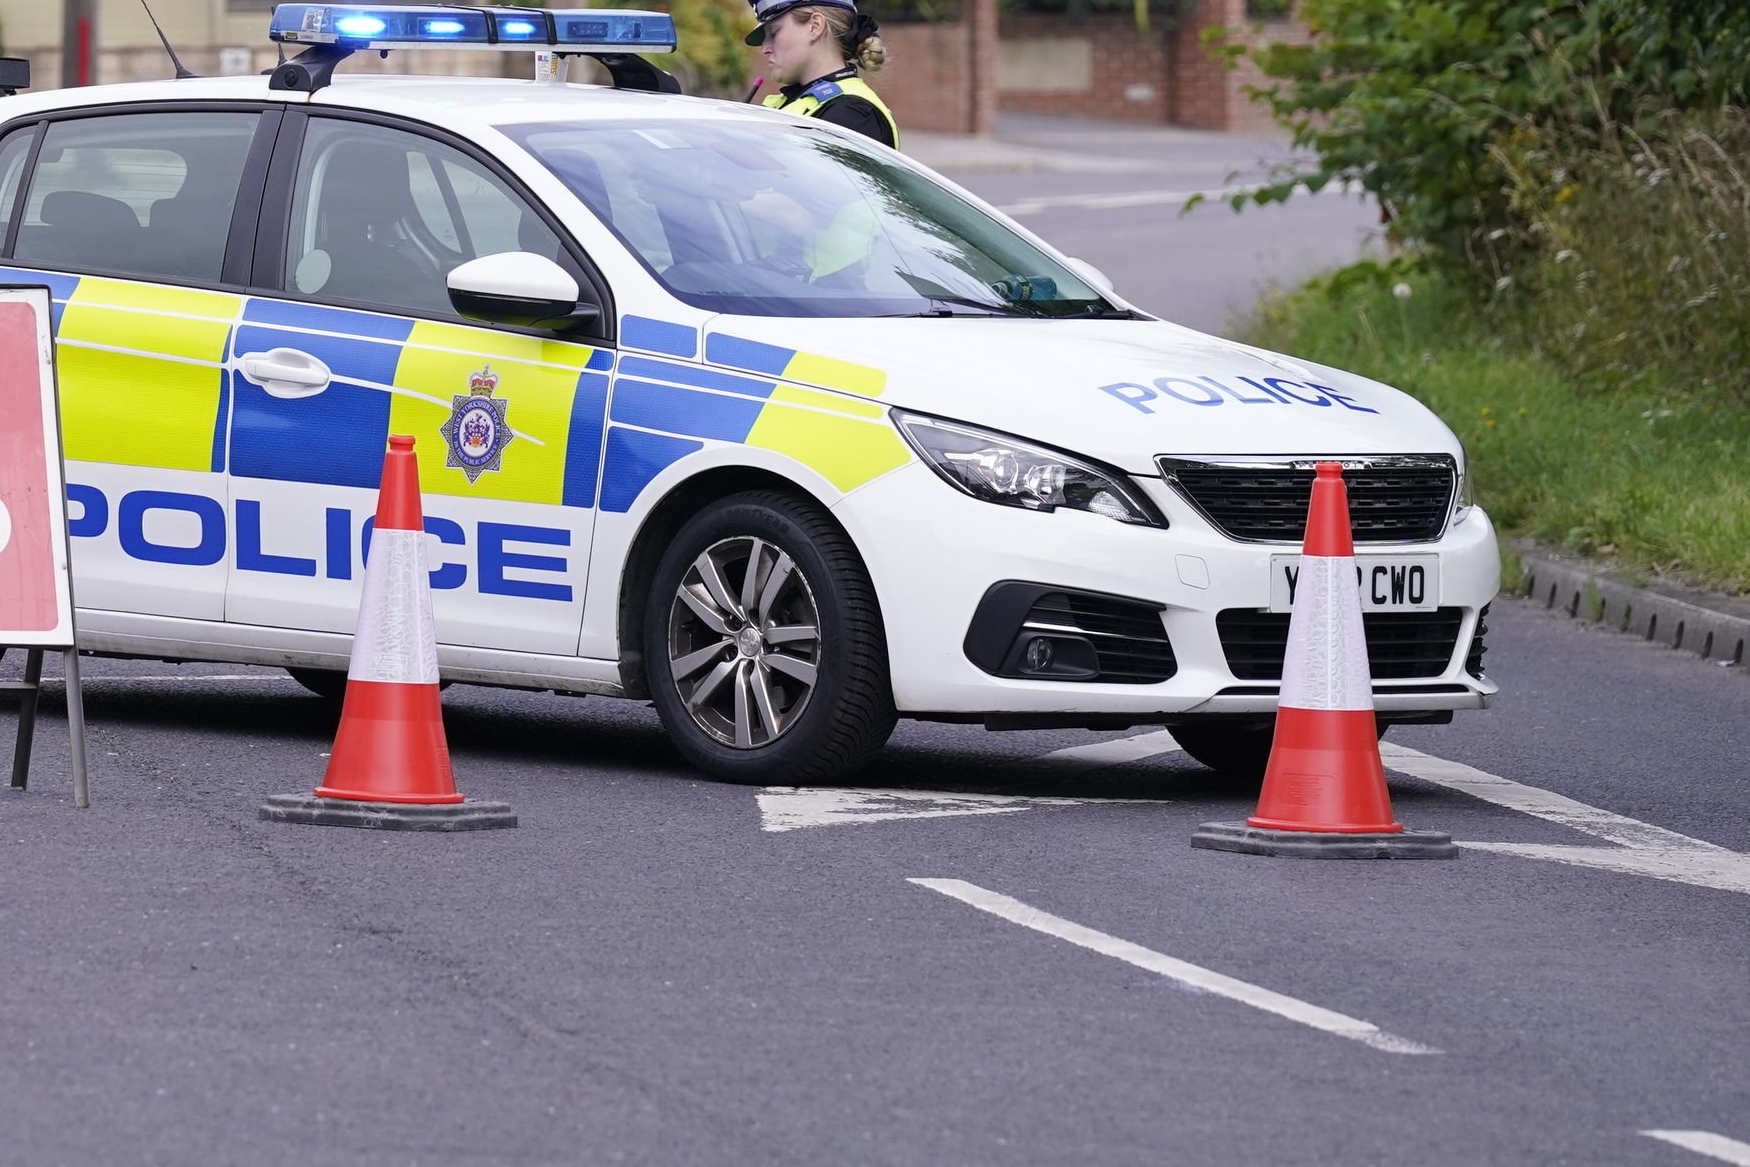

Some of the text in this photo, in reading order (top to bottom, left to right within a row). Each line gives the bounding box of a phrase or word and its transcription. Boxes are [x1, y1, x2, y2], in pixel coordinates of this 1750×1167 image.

[1098, 375, 1381, 415] POLICE
[453, 399, 501, 437] WEST YORKSHIRE POLICE
[1371, 565, 1425, 605] CWO
